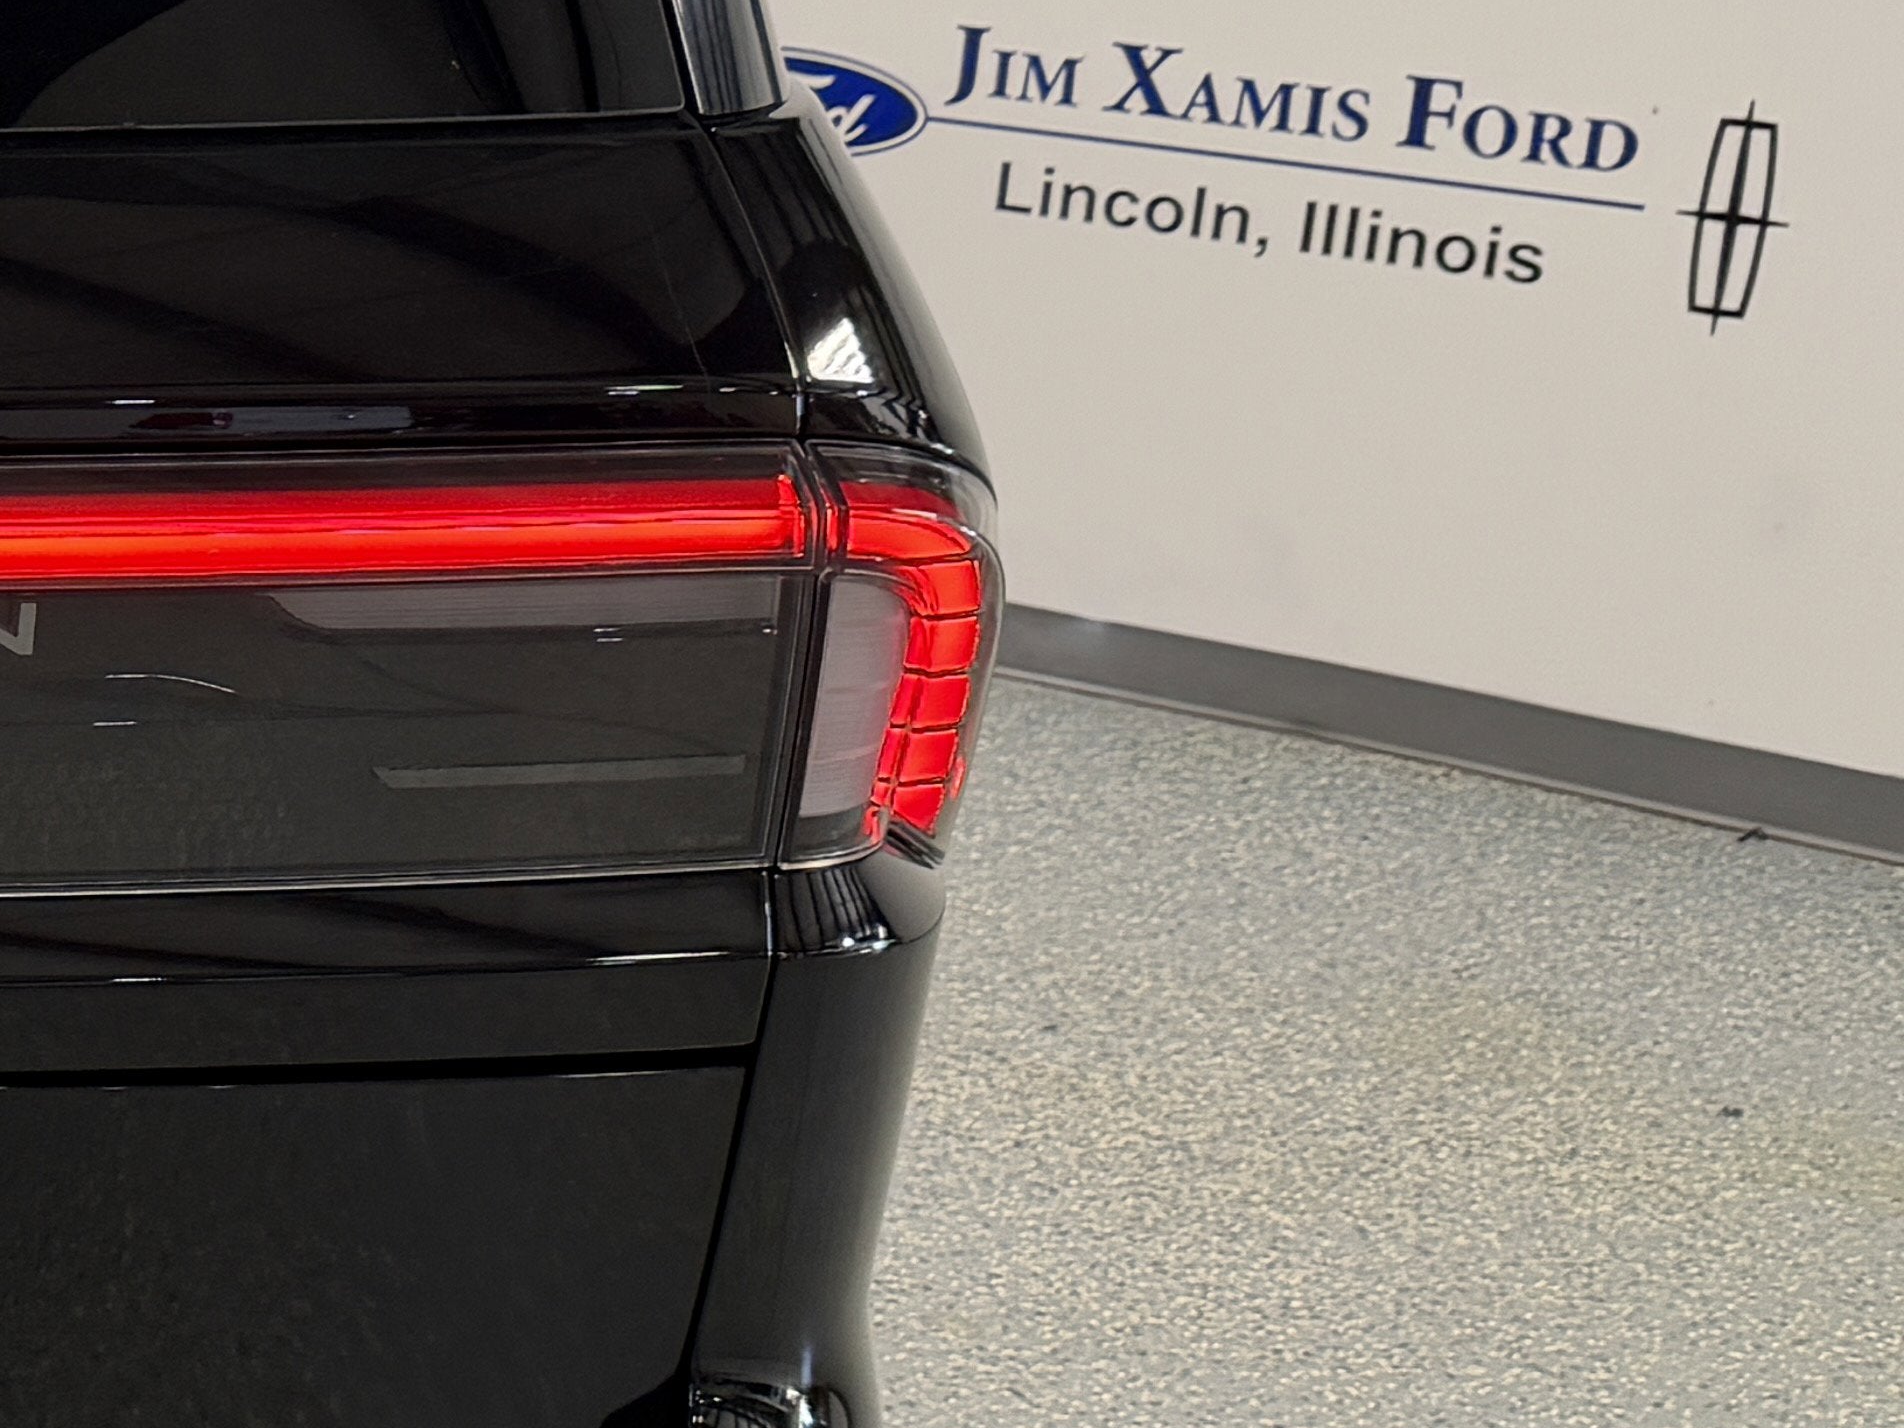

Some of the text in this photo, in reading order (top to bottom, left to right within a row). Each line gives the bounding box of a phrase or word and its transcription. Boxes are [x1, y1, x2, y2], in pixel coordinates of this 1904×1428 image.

[944, 25, 1640, 173] JIM XAMIS FORD
[994, 161, 1544, 284] Lincoln, Illinois
